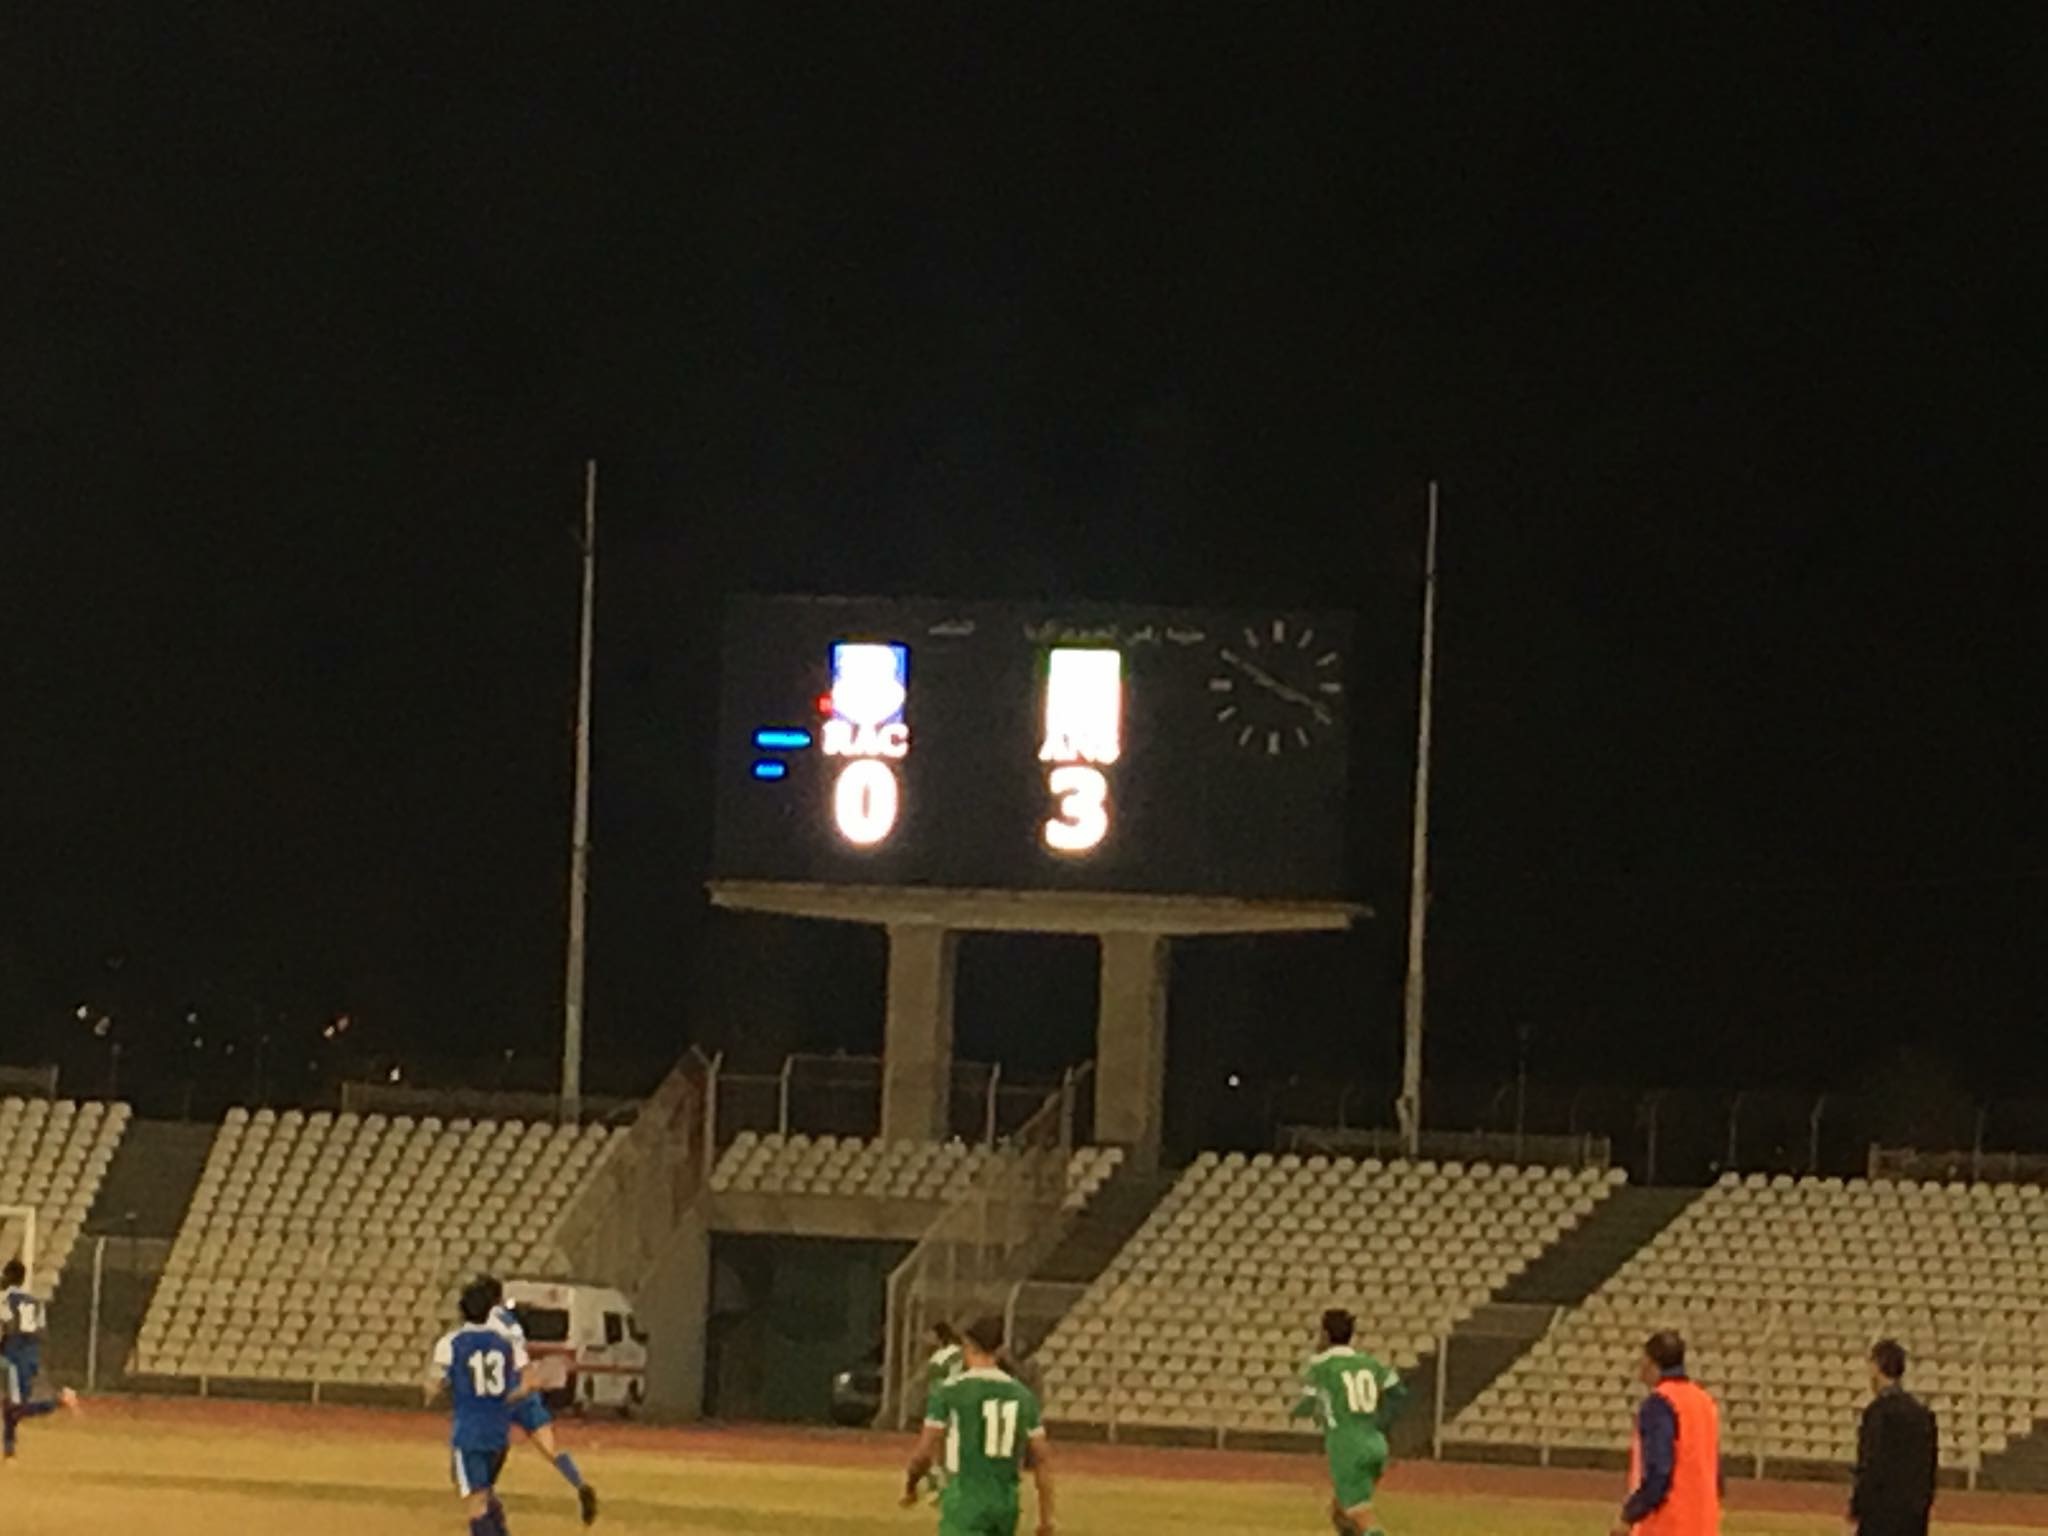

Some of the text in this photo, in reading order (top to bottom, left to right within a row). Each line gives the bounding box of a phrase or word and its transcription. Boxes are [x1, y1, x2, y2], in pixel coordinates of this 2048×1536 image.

[822, 720, 909, 757] RAC
[835, 760, 898, 844] 0
[1046, 767, 1108, 849] 3
[468, 1350, 506, 1396] 13
[1341, 1369, 1377, 1413] 10
[982, 1399, 1019, 1458] 11
